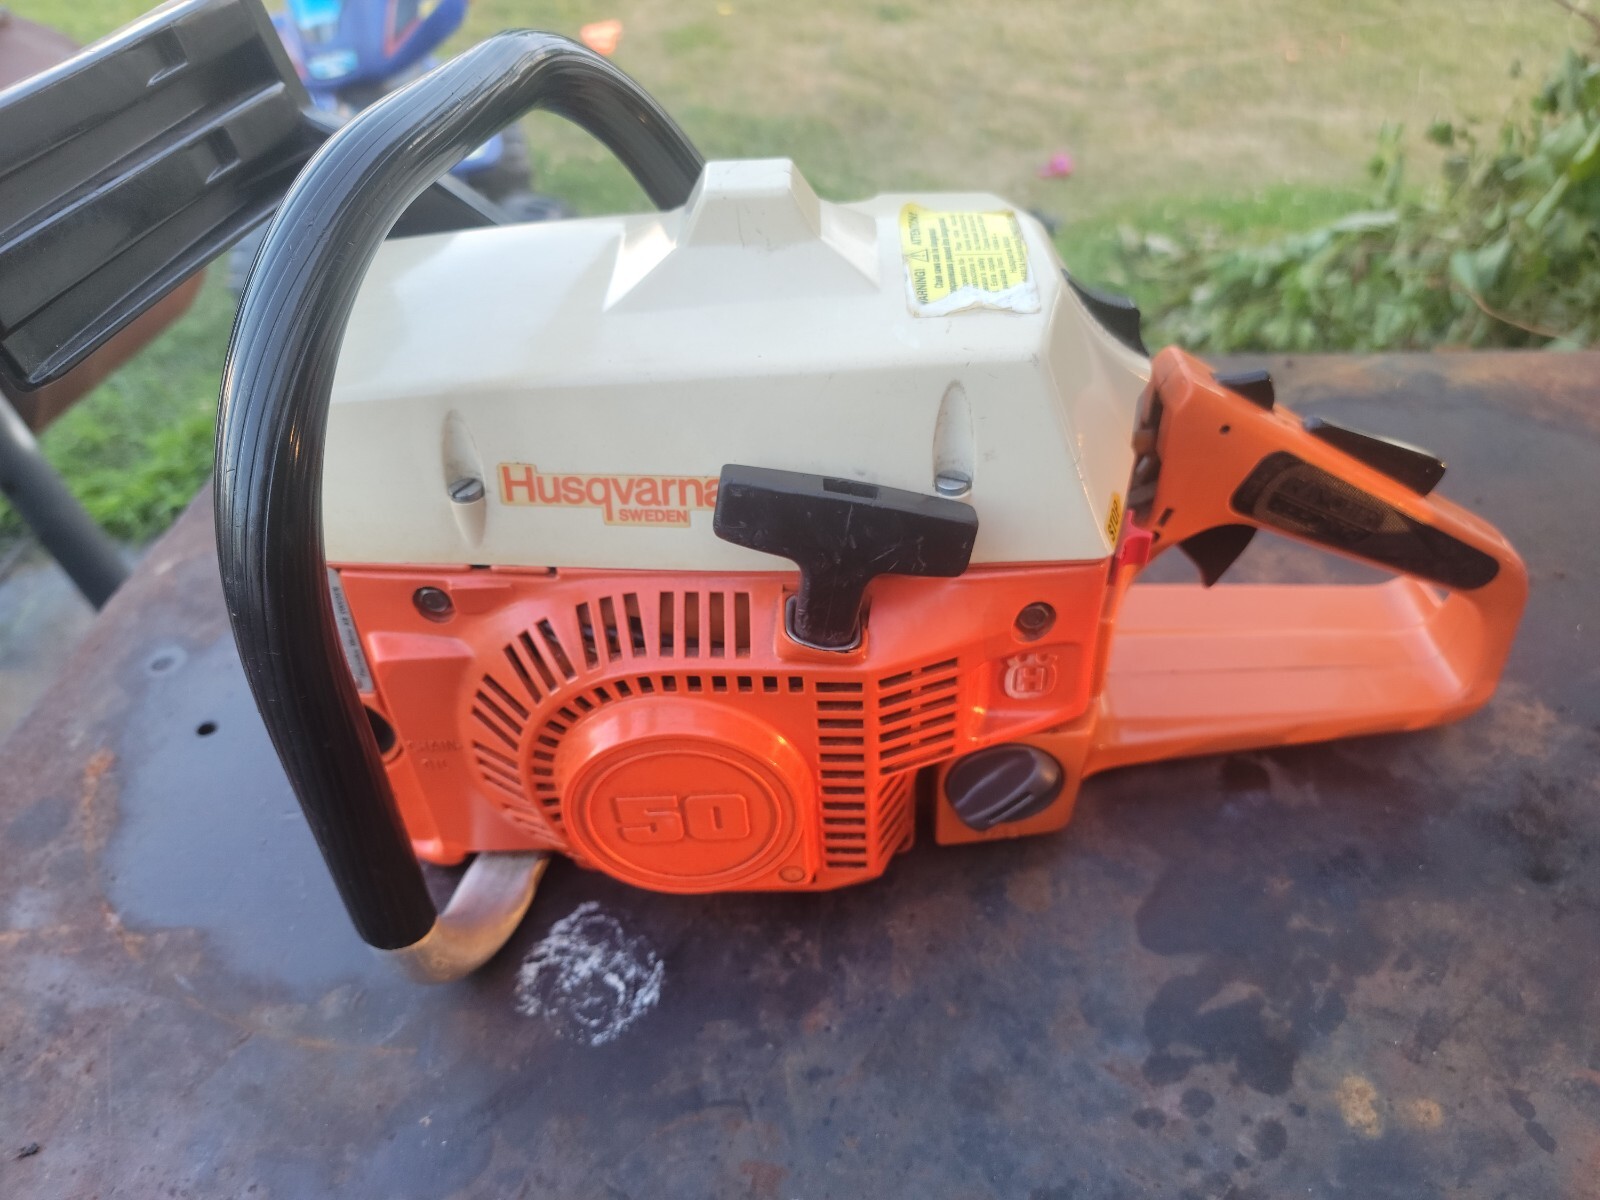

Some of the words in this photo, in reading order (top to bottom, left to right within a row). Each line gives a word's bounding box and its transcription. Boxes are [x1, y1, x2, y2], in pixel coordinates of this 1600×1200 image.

[619, 508, 688, 523] SWEDEN
[1108, 499, 1120, 543] STOP
[609, 793, 751, 845] 50
